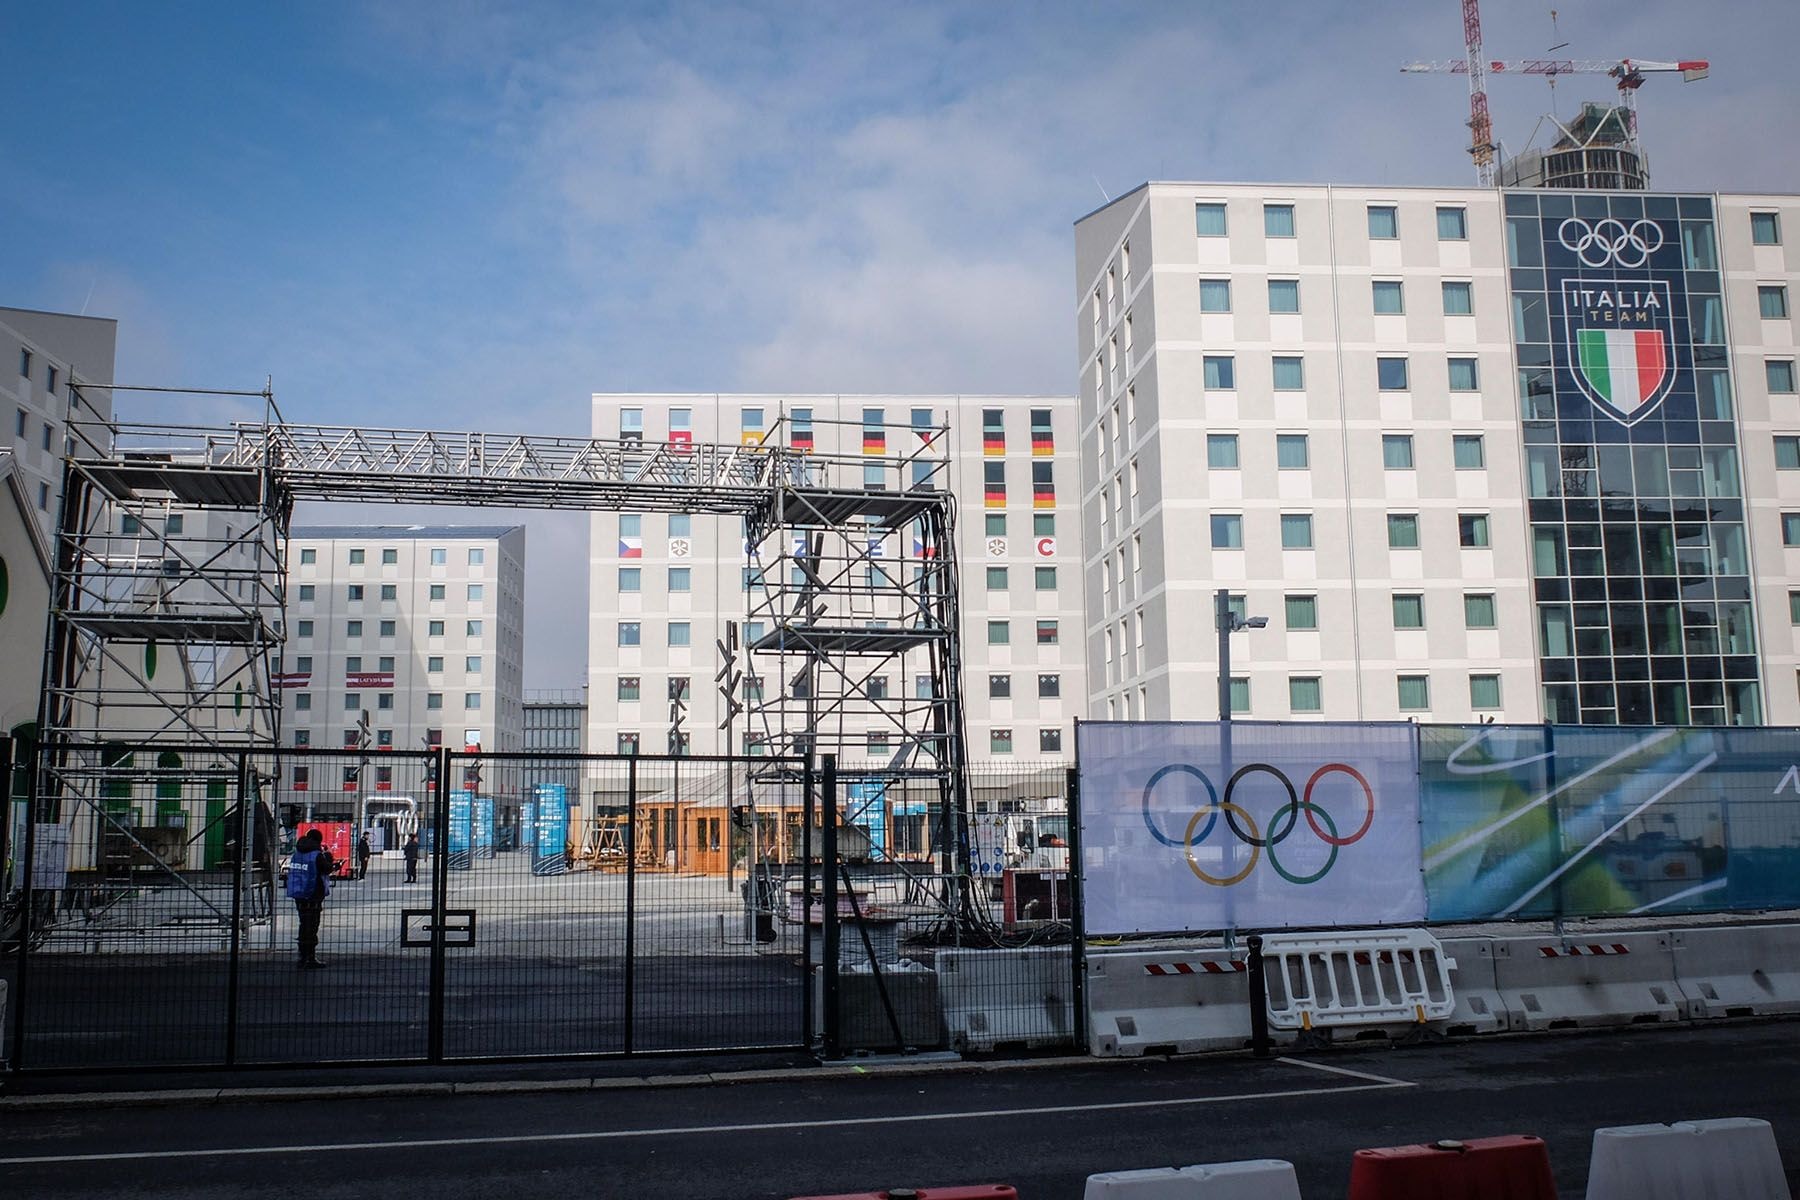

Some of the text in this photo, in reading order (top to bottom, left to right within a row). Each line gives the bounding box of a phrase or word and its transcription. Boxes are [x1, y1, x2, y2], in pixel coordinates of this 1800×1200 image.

[1572, 290, 1661, 309] ITALIA
[1590, 310, 1648, 322] TEAM
[675, 437, 687, 450] E
[794, 539, 808, 557] Z
[868, 539, 883, 556] E
[1038, 538, 1054, 556] C
